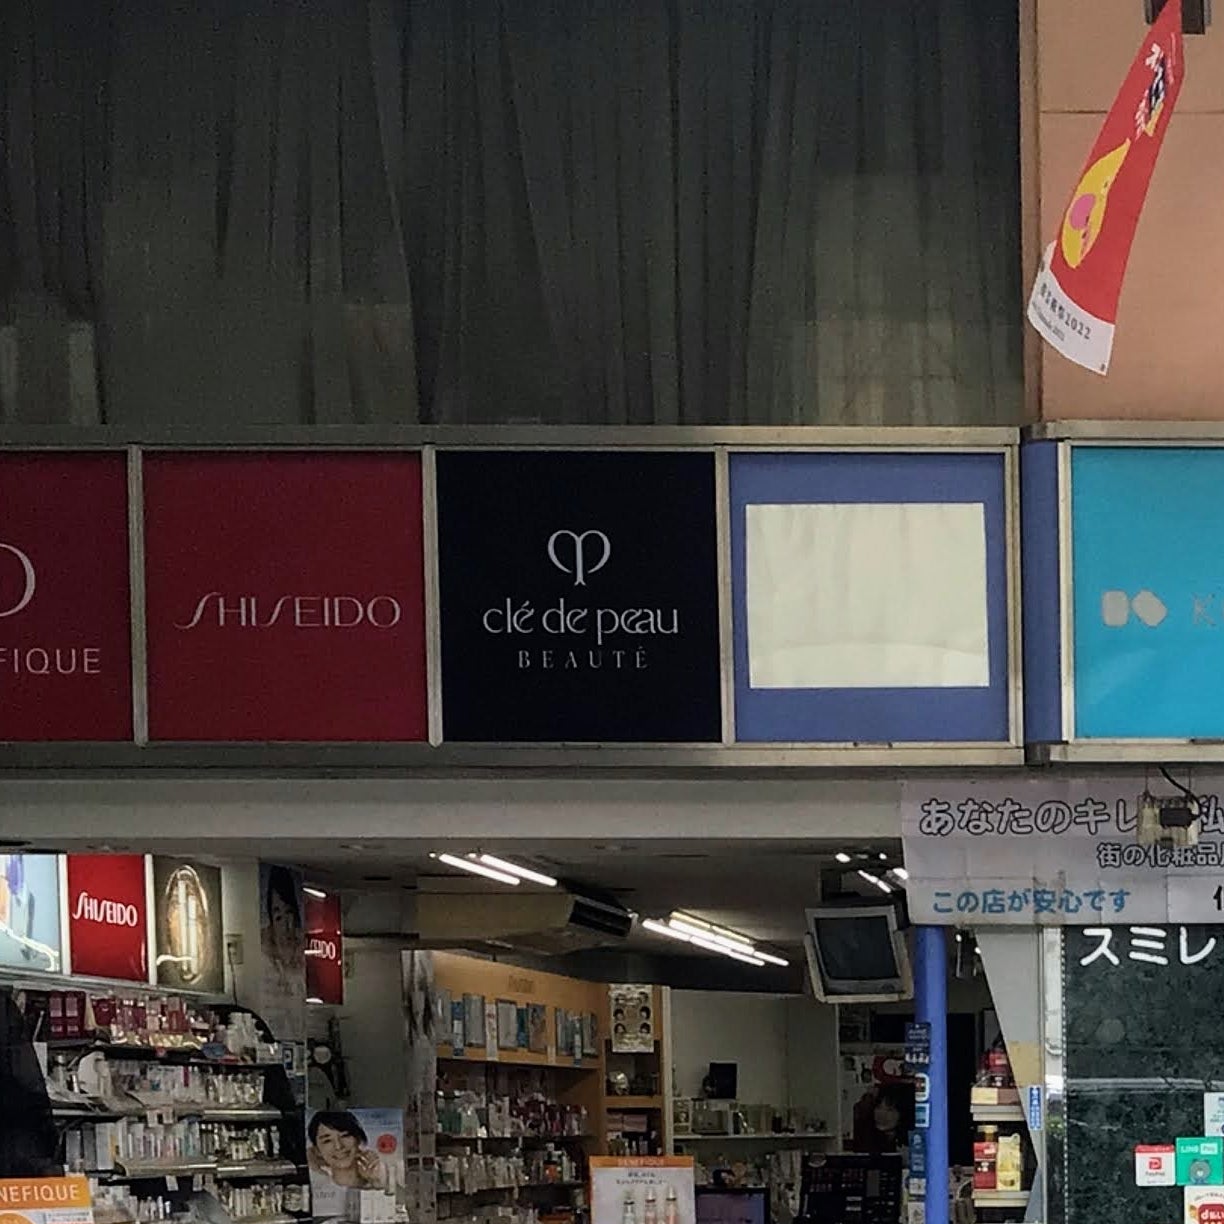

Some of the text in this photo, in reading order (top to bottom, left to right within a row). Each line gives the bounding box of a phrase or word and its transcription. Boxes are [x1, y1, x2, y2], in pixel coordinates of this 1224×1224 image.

[174, 592, 401, 630] SHISEIDO
[482, 599, 680, 647] clé de peau
[516, 646, 649, 670] BEAUTÉ
[72, 891, 138, 927] SHISEIDO
[932, 887, 1131, 915] この店が安心です
